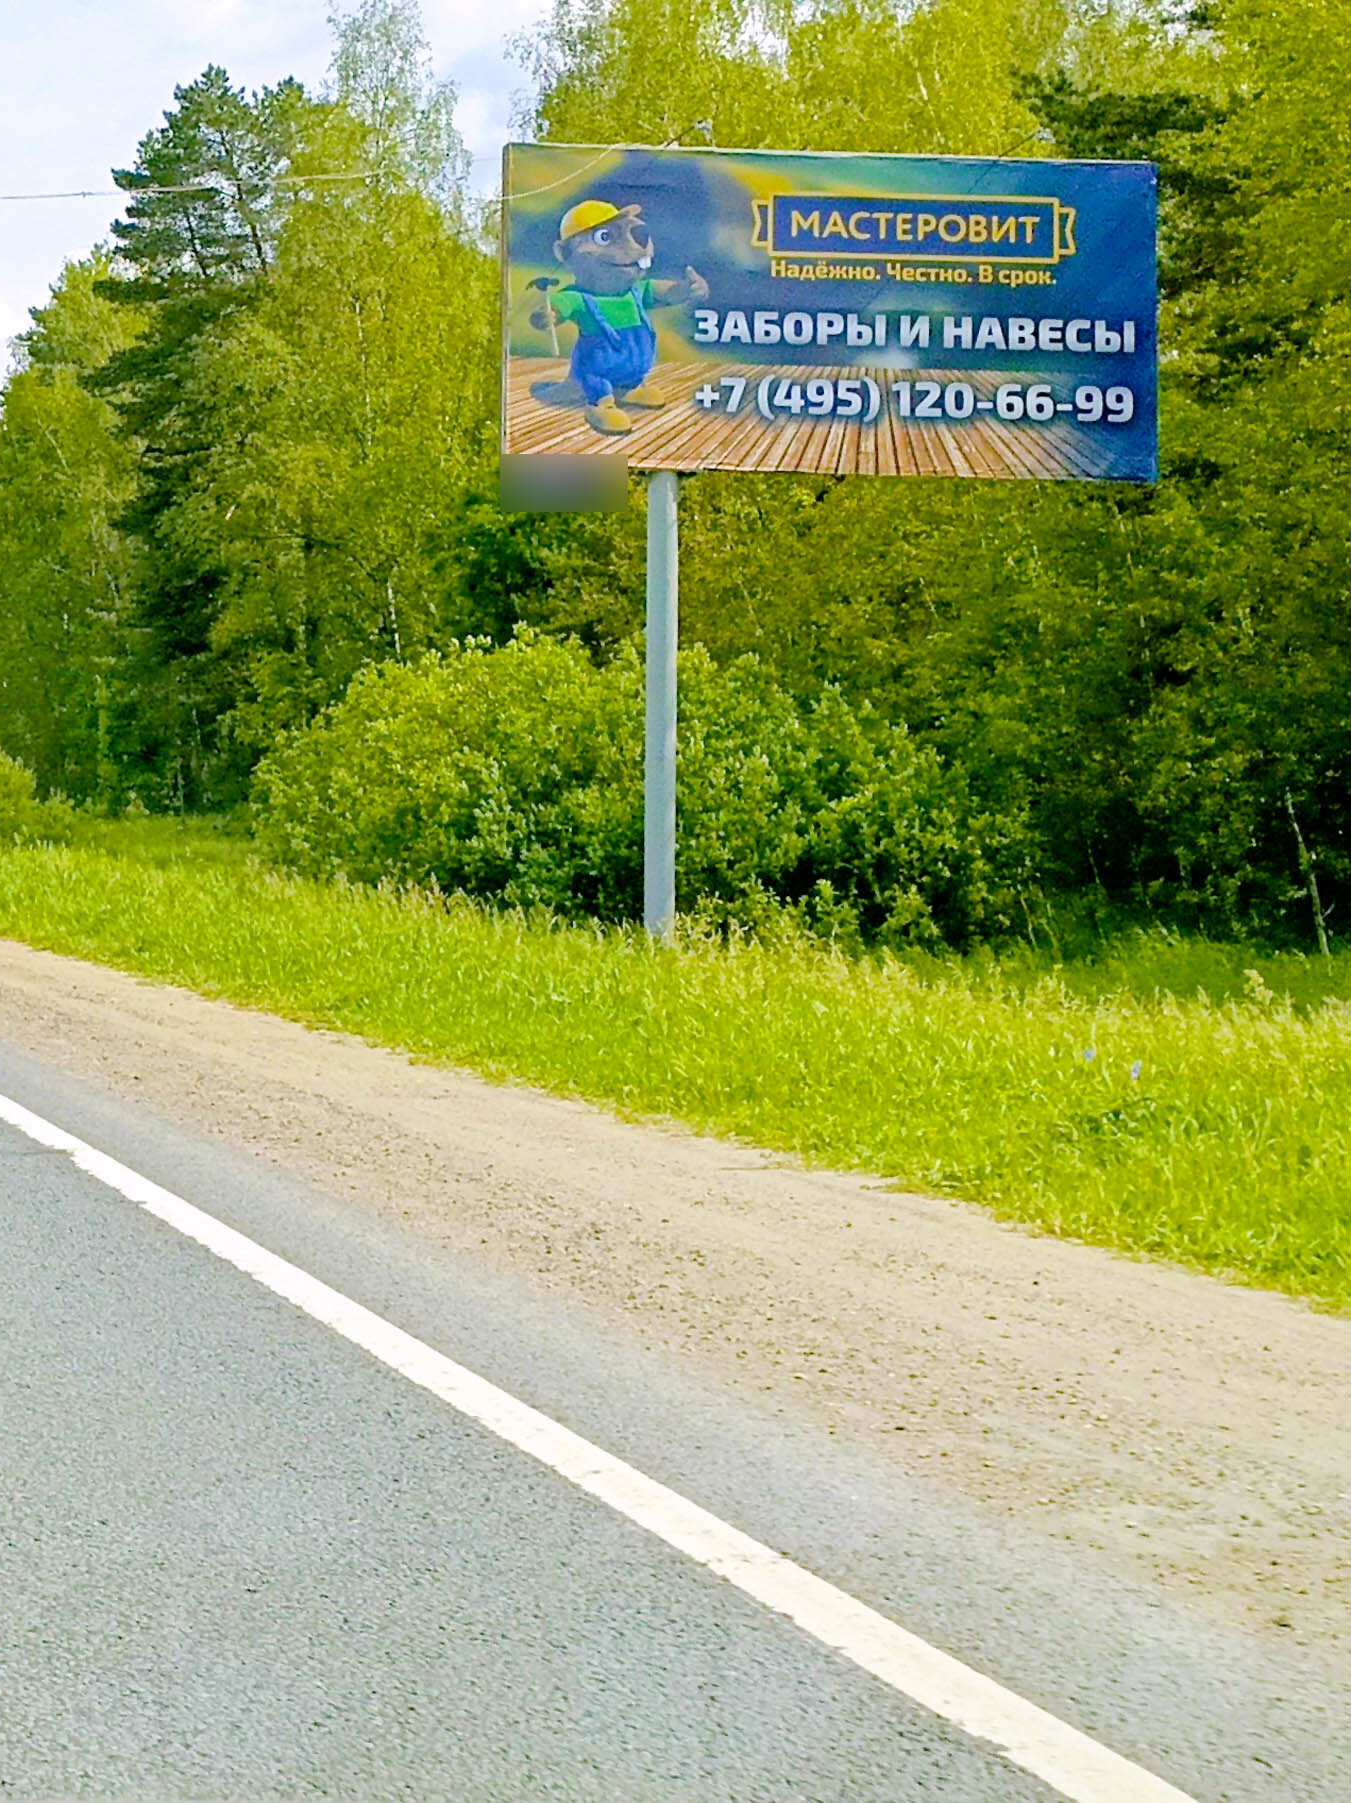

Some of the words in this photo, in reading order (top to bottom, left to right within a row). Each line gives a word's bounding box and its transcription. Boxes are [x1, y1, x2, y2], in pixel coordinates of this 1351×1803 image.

[789, 209, 1041, 245] МАСТЕРОВИТ
[769, 259, 882, 282] Надёжно.
[886, 262, 973, 283] Честно.
[978, 265, 993, 283] В
[998, 268, 1057, 288] срок.
[693, 309, 887, 346] ЗАБОРЫ
[899, 314, 930, 348] И
[942, 316, 1136, 354] НАВЕСЫ
[694, 376, 746, 413] +7
[757, 374, 881, 422] (495)
[891, 380, 1135, 423] 120-66-99
